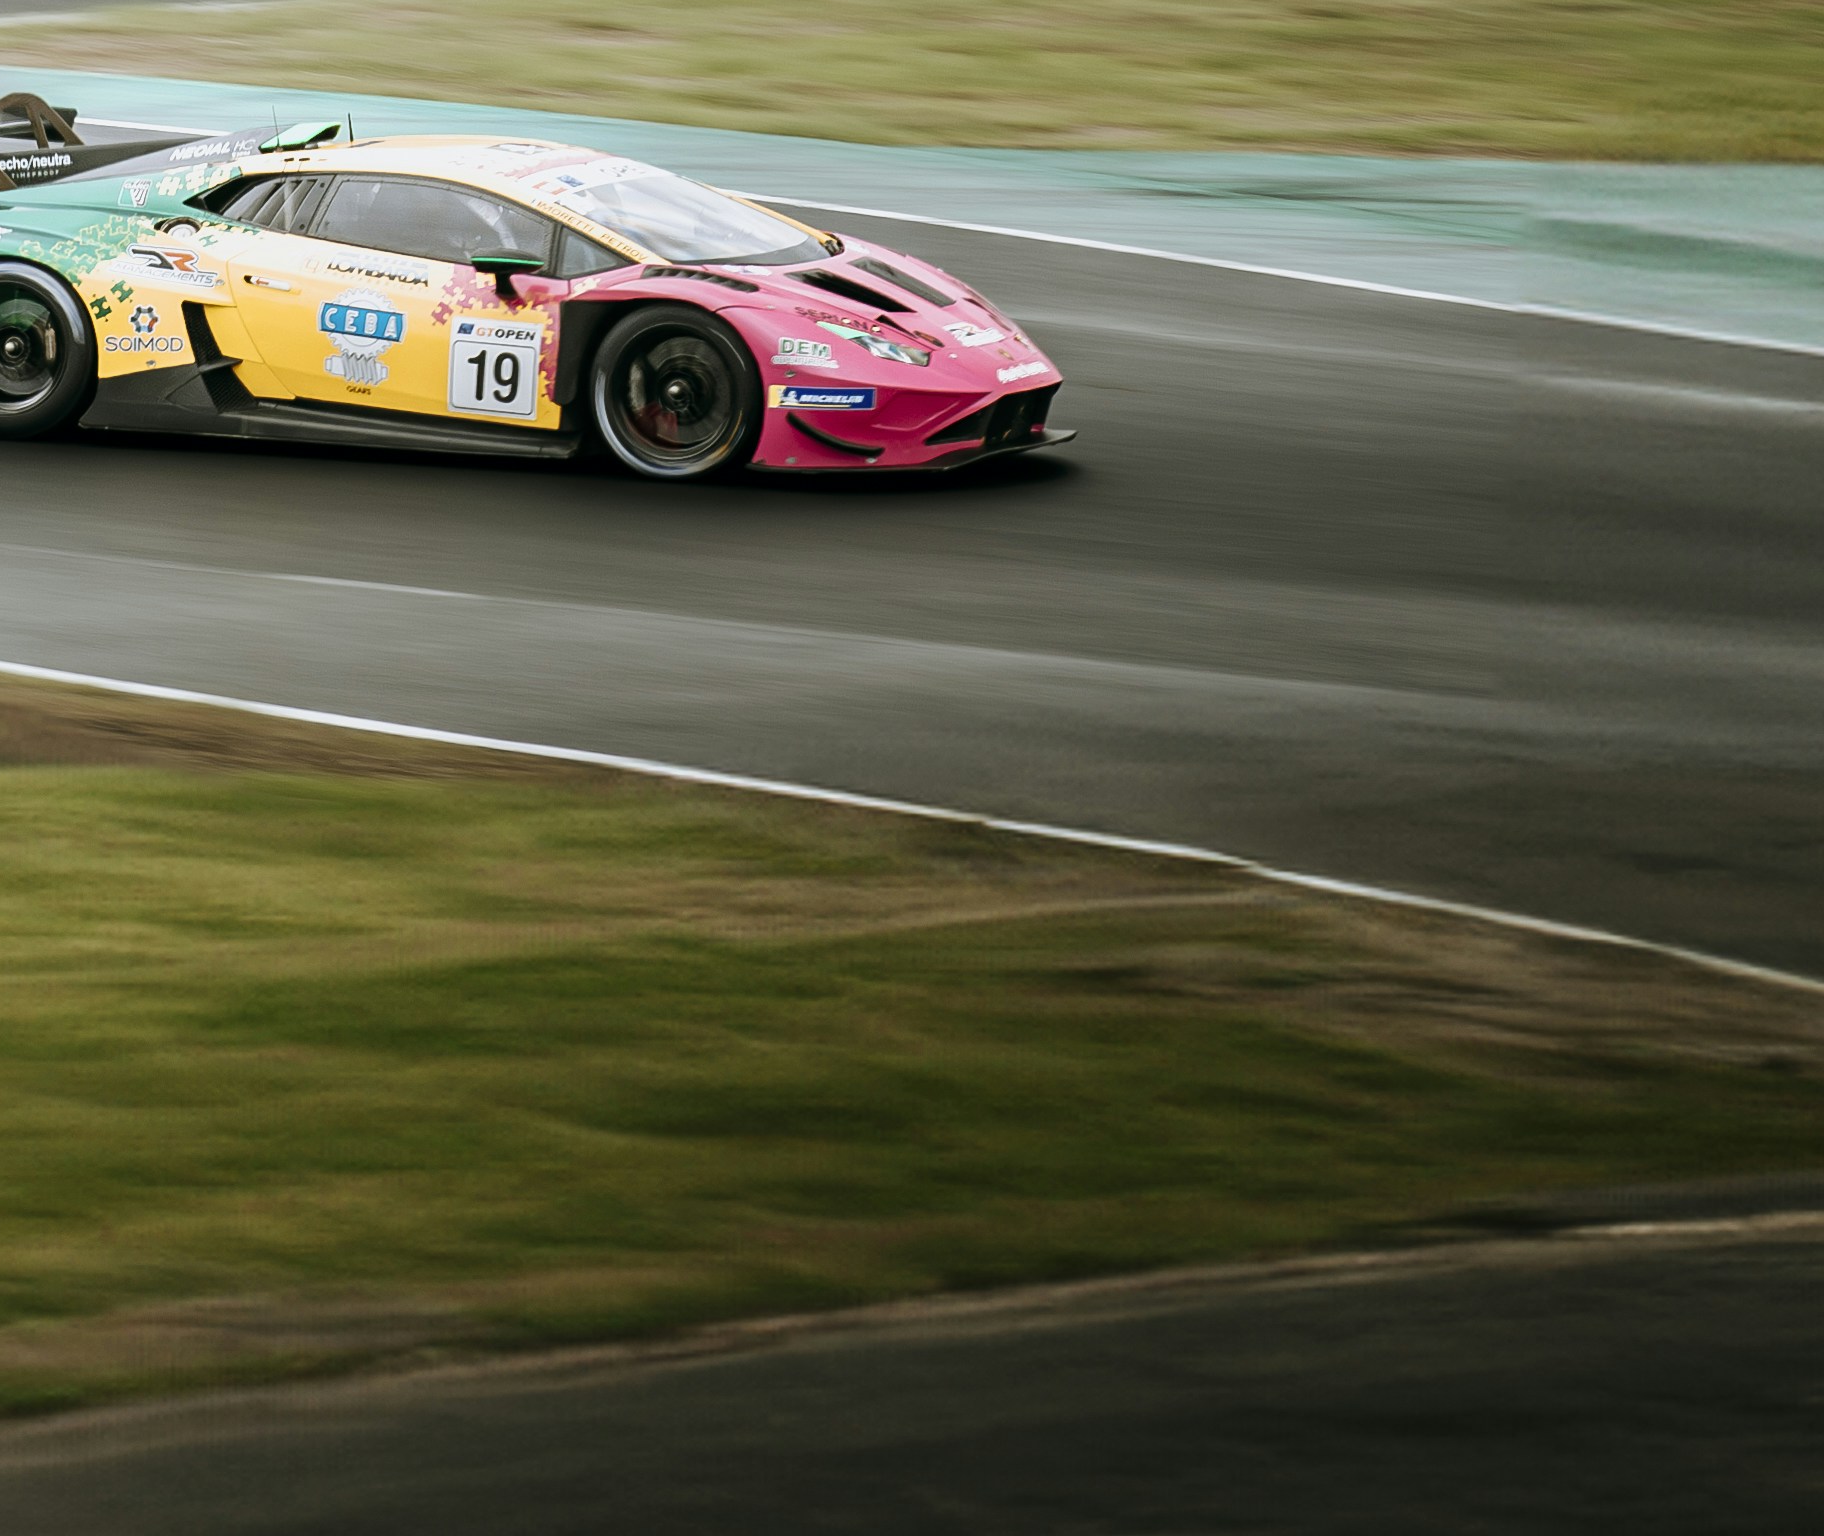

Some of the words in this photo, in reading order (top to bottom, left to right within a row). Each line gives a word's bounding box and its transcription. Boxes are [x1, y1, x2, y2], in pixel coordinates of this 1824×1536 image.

[113, 263, 215, 285] MANAGEMENTS
[324, 308, 398, 339] CEBA
[105, 336, 184, 352] SOIMOD
[467, 349, 520, 404] 19
